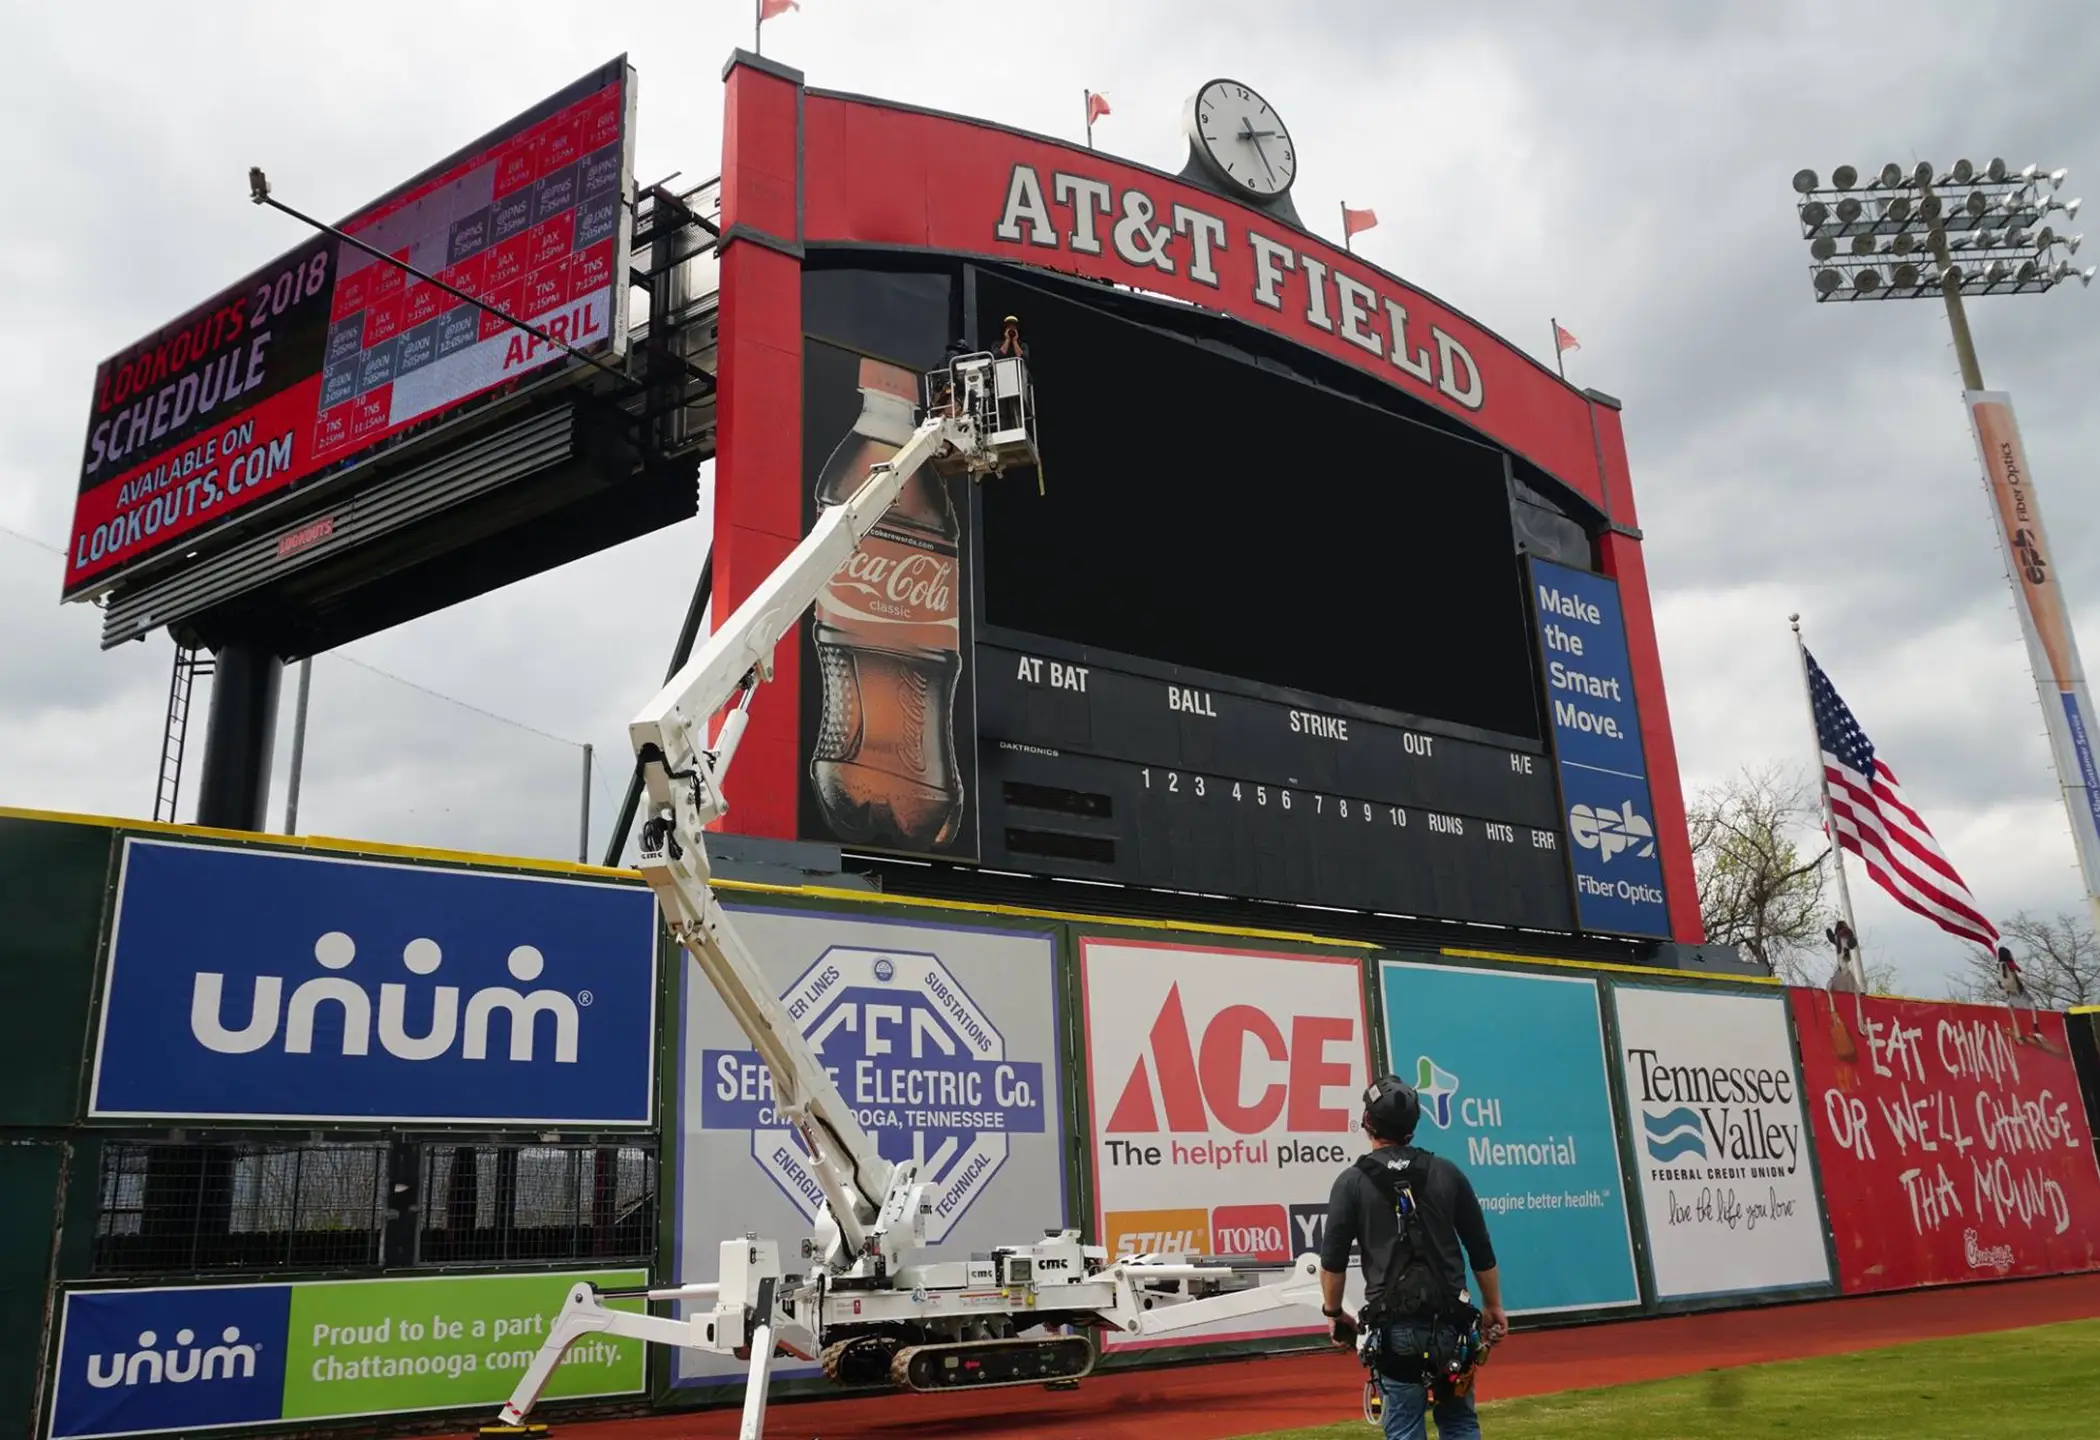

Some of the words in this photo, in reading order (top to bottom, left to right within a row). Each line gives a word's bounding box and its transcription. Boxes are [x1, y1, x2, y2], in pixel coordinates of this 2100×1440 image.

[1236, 87, 1250, 101] 12
[1201, 113, 1209, 124] 9
[1284, 150, 1292, 161] 3
[1248, 178, 1256, 189] 6
[581, 202, 613, 230] @JXN
[583, 255, 603, 276] TNS
[535, 277, 555, 297] TNS
[994, 162, 1228, 291] AT&T
[1248, 230, 1485, 412] FIELD
[99, 296, 247, 414] LOOKOUTS
[249, 250, 328, 329] 2018
[503, 302, 599, 370] APRIL
[86, 331, 272, 475] SCHEDULE
[363, 400, 380, 418] TNS
[325, 417, 341, 435] TNS
[116, 438, 217, 508] AVAILABLE
[222, 419, 254, 455] ON
[2001, 441, 2020, 486] Optics
[75, 430, 294, 571] LOOKOUTS.COM
[2012, 487, 2030, 522] Fiber
[278, 520, 334, 553] LOOKOUTS
[869, 600, 911, 618] classic
[1539, 585, 1601, 625] Make
[1544, 623, 1584, 656] the
[1017, 656, 1043, 684] AT
[1050, 662, 1089, 692] BAT
[1550, 661, 1621, 702] Smart
[1168, 685, 1217, 717] BALL
[1290, 710, 1348, 741] STRIKE
[1555, 699, 1624, 740] Move.
[1403, 732, 1433, 757] OUT
[1141, 768, 1150, 788] 1
[1168, 772, 1179, 793] 2
[1195, 776, 1205, 797] 3
[1231, 782, 1242, 801] 4
[1257, 786, 1267, 806] 5
[1281, 790, 1291, 810] 6
[1314, 794, 1323, 814] 7
[1339, 799, 1348, 818] 8
[1363, 803, 1372, 822] 9
[1389, 808, 1407, 827] 10
[1428, 813, 1464, 836] RUNS
[1486, 822, 1514, 843] HITS
[1531, 829, 1556, 850] ERR
[1570, 799, 1654, 864] epb
[1577, 874, 1615, 898] Fiber
[1617, 880, 1663, 905] Optics
[190, 931, 579, 1063] unum
[804, 965, 840, 1003] LINES
[924, 971, 992, 1052] SUBSTATIONS
[1105, 980, 1354, 1135] ACE
[1865, 1016, 1926, 1084] EAT
[1937, 1019, 2020, 1092] CHIKIN
[856, 1059, 982, 1105] ELECTRIC
[1628, 1049, 1793, 1104] Tennessee
[905, 1110, 1005, 1128] TENNESSEE
[1461, 1098, 1502, 1127] CHI
[1825, 1088, 1876, 1160] OR
[1878, 1082, 1974, 1158] WE'LL
[1976, 1089, 2080, 1155] CHARGE
[1105, 1140, 1162, 1166] The
[1172, 1140, 1269, 1170] helpful
[1277, 1140, 1351, 1168] place.
[1468, 1136, 1576, 1166] Memorial
[1699, 1107, 1798, 1175] Valley
[934, 1152, 993, 1219] TECHNICAL
[1652, 1170, 1702, 1181] FEDERAL
[1707, 1168, 1746, 1180] CREDIT
[1751, 1166, 1785, 1178] UNION
[1527, 1192, 1562, 1209] better
[1564, 1190, 1604, 1208] health.
[1668, 1190, 1692, 1226] live
[1696, 1187, 1714, 1220] the
[1716, 1188, 1742, 1230] life
[1745, 1206, 1767, 1230] you
[1770, 1186, 1794, 1220] love
[1899, 1163, 1963, 1236] THA
[1970, 1155, 2070, 1235] MOUND
[1117, 1230, 1200, 1256] STIHL
[971, 1270, 993, 1278] cmc
[1037, 1258, 1069, 1270] cmc
[312, 1318, 390, 1347] Proud
[399, 1318, 425, 1341] to
[433, 1315, 463, 1339] be
[472, 1320, 486, 1337] a
[494, 1313, 542, 1342] part
[86, 1326, 256, 1388] unum
[311, 1354, 477, 1382] Chattanooga
[485, 1340, 622, 1371] comunity.
